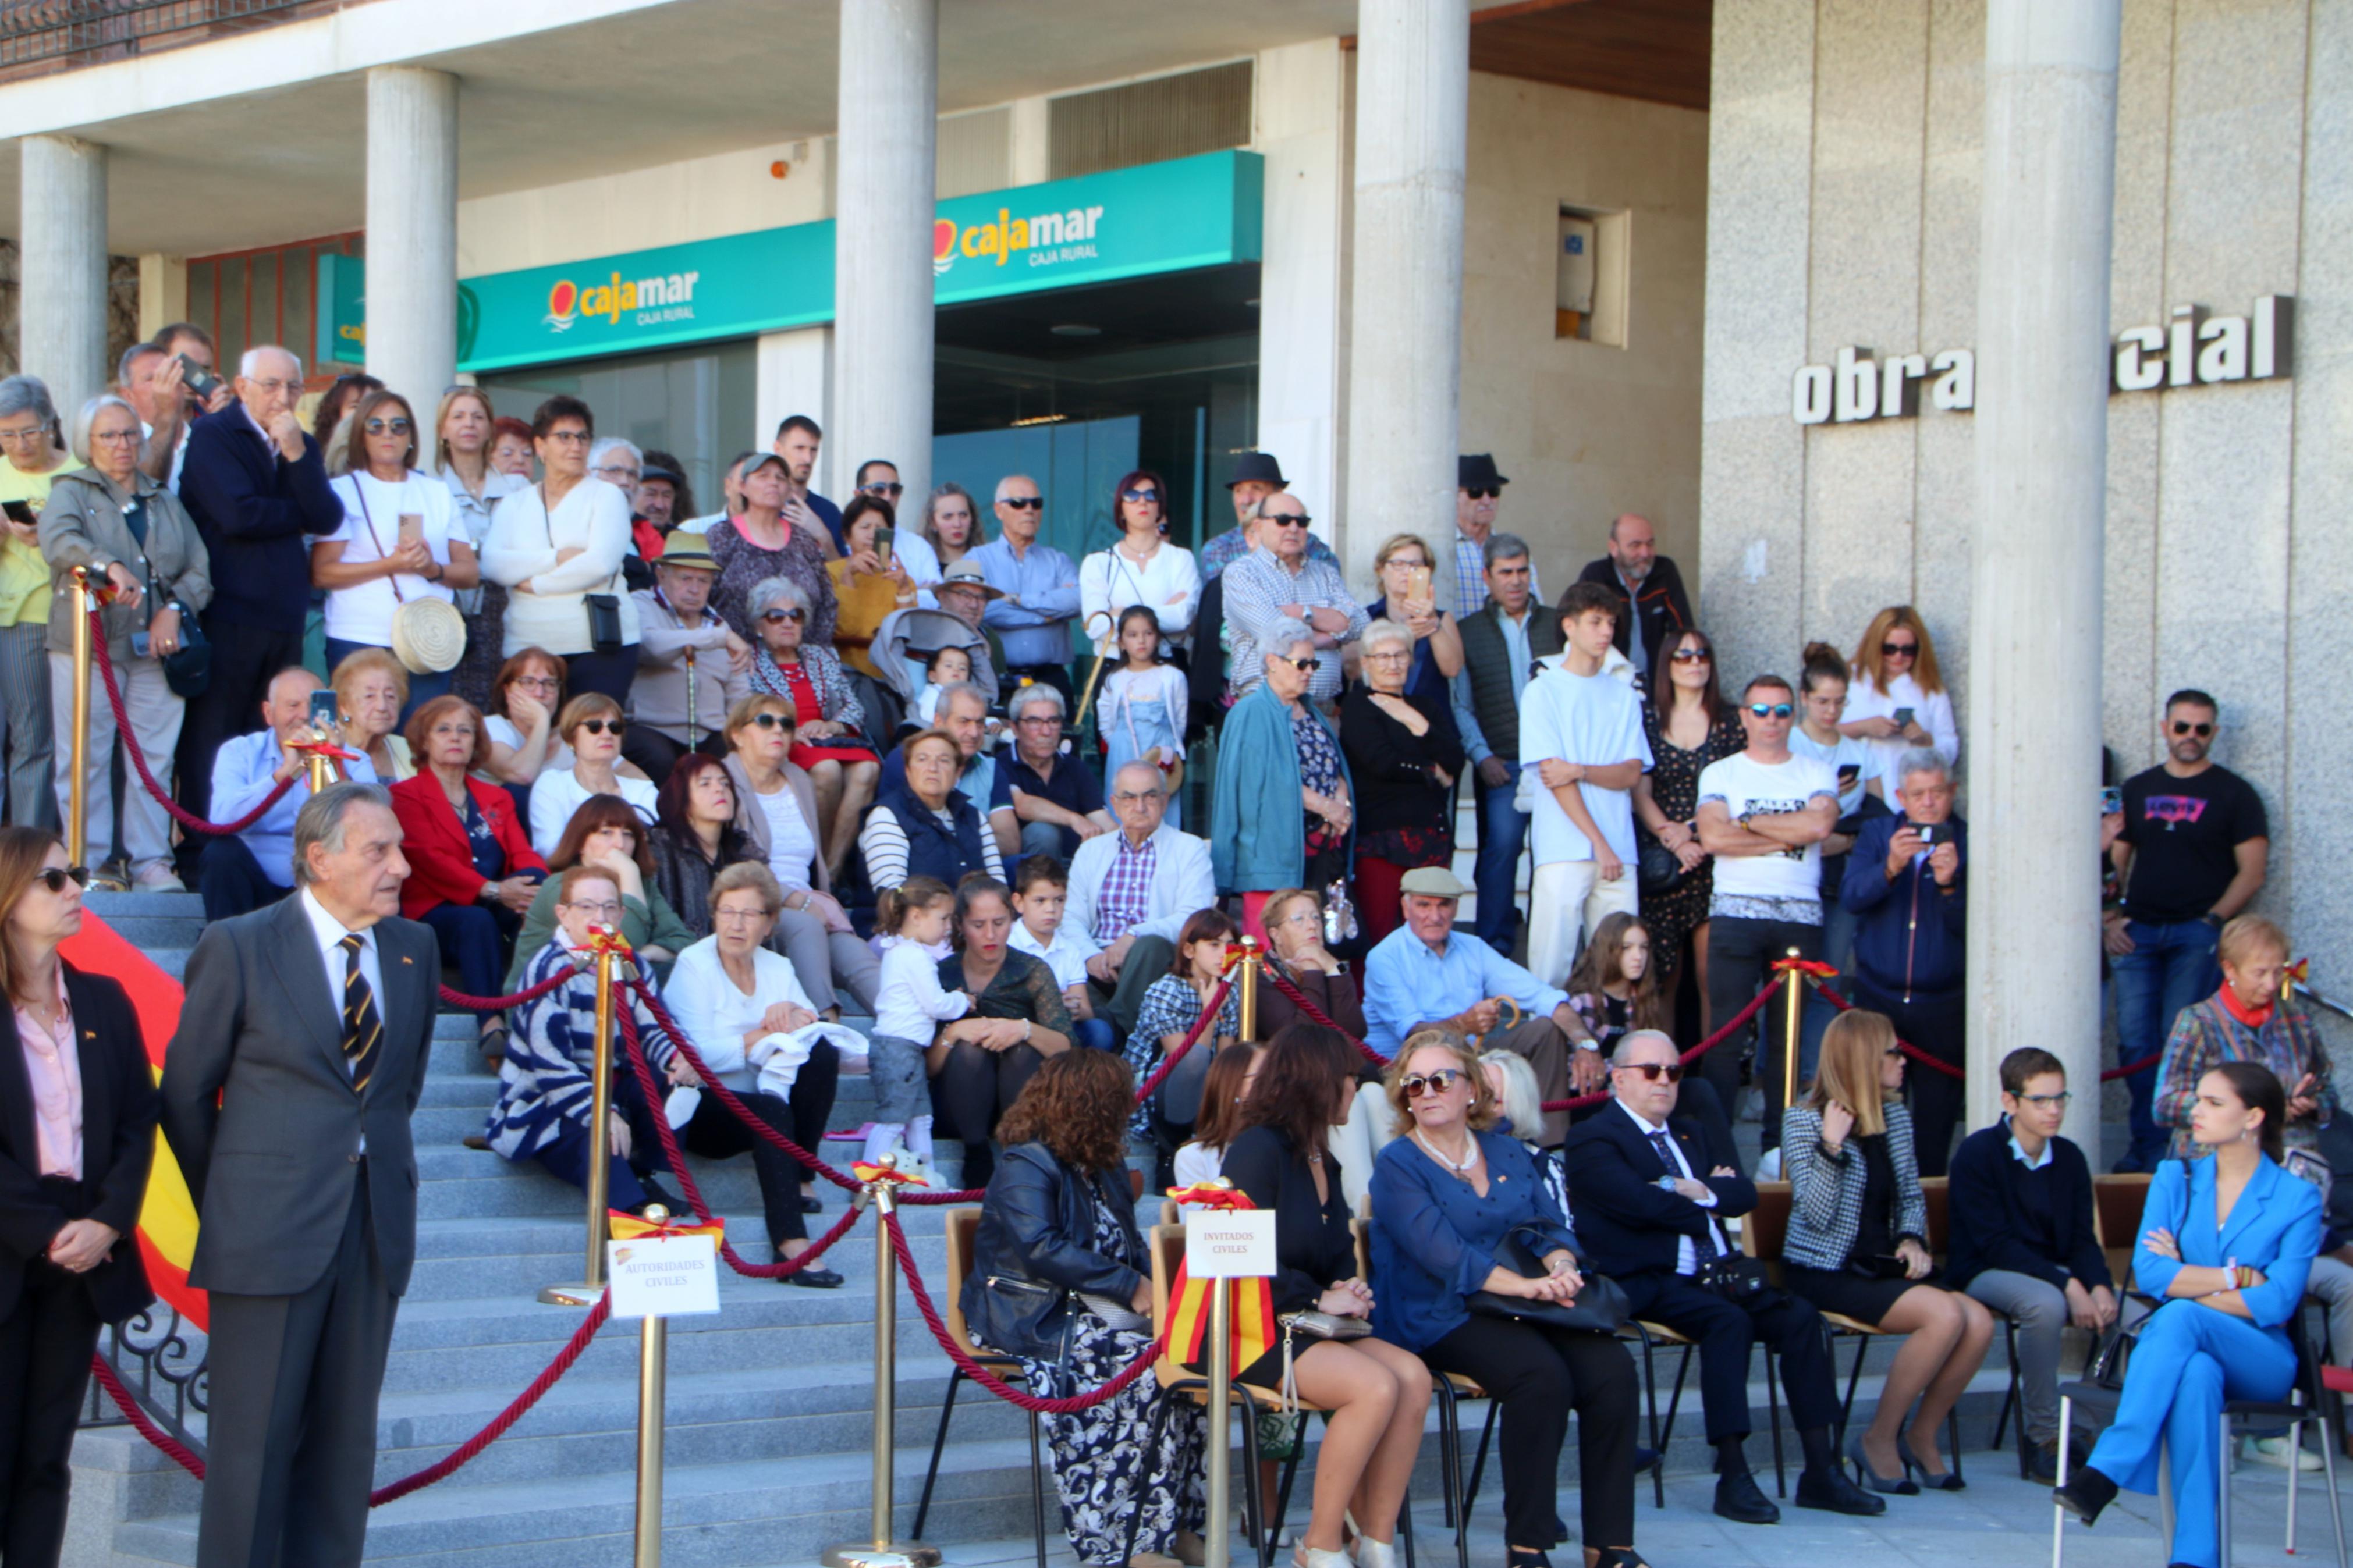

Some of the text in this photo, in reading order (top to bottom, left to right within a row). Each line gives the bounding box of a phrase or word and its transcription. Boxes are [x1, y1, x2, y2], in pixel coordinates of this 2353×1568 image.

[961, 205, 1103, 266] cajamar
[1028, 244, 1099, 268] CAJA RURAL
[580, 271, 699, 324] cajamar
[637, 306, 695, 325] CAJA RURAL
[1793, 294, 2276, 425] obra cial
[1204, 1232, 1254, 1241] INVITADOS
[1212, 1245, 1248, 1254] CIVILES
[625, 1260, 705, 1274] AUTORIDADES
[645, 1276, 688, 1288] CIVILES
